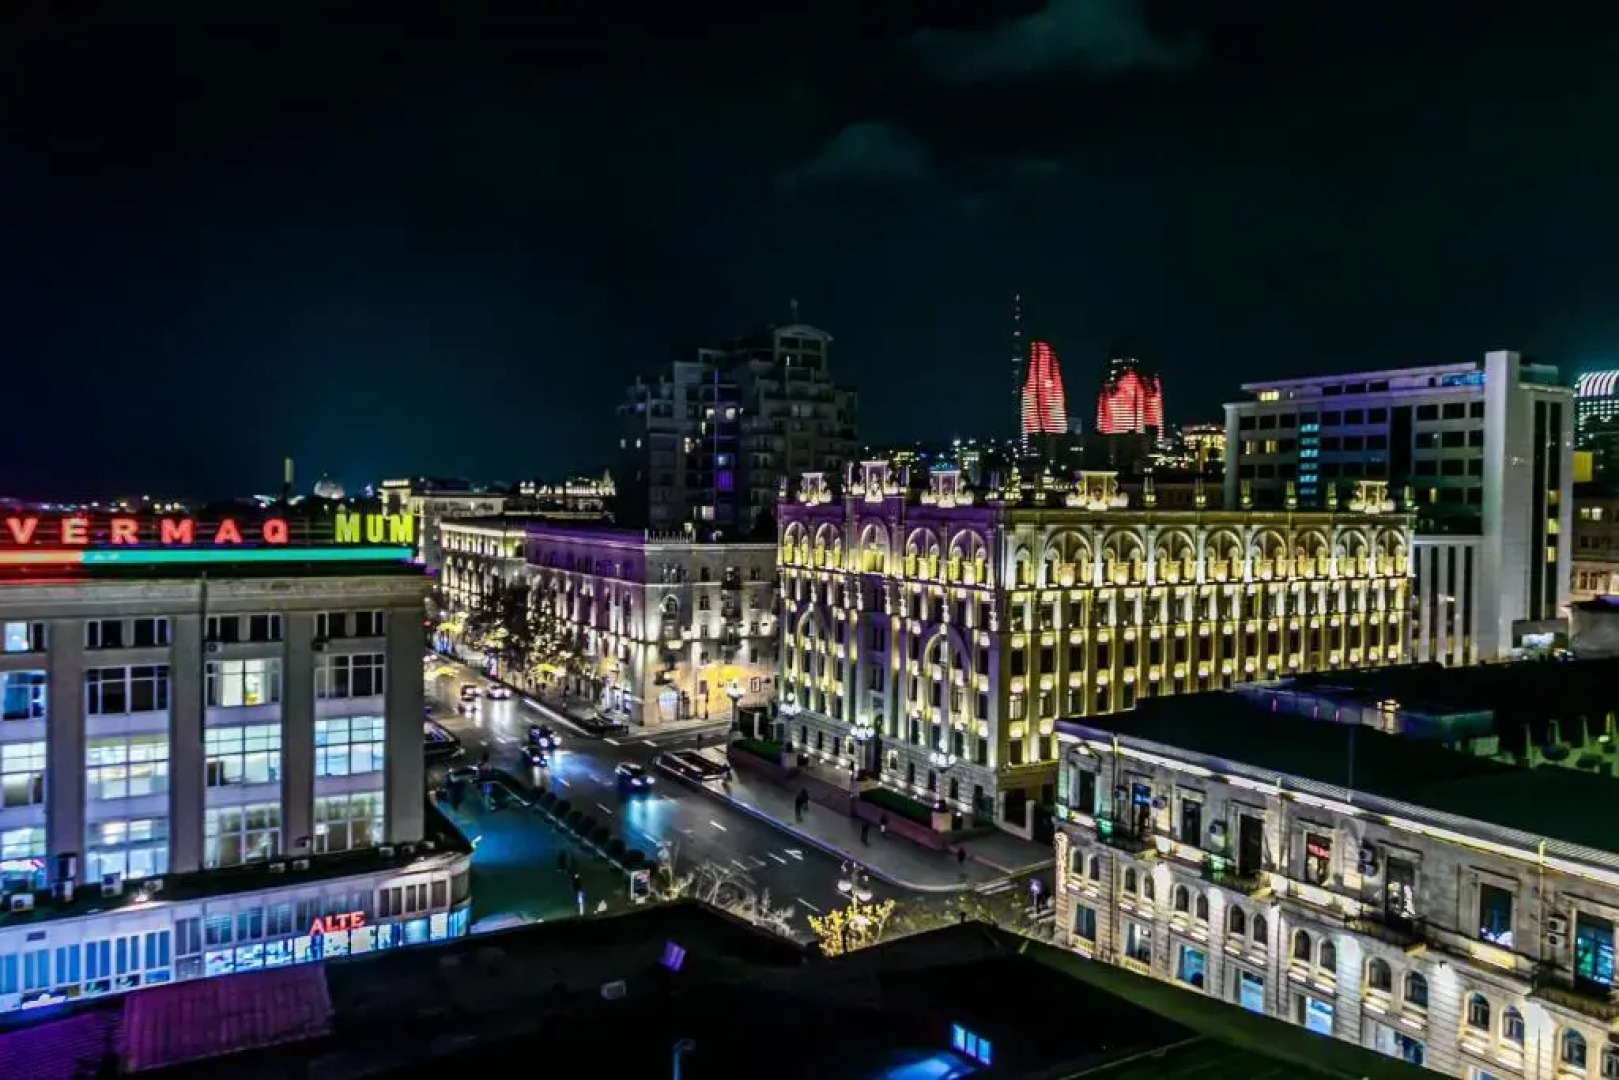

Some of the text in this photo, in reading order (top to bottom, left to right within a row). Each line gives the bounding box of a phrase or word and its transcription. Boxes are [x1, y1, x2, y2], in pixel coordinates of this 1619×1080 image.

[6, 513, 414, 545] VERMAQ MUM
[309, 910, 365, 937] ALTE
